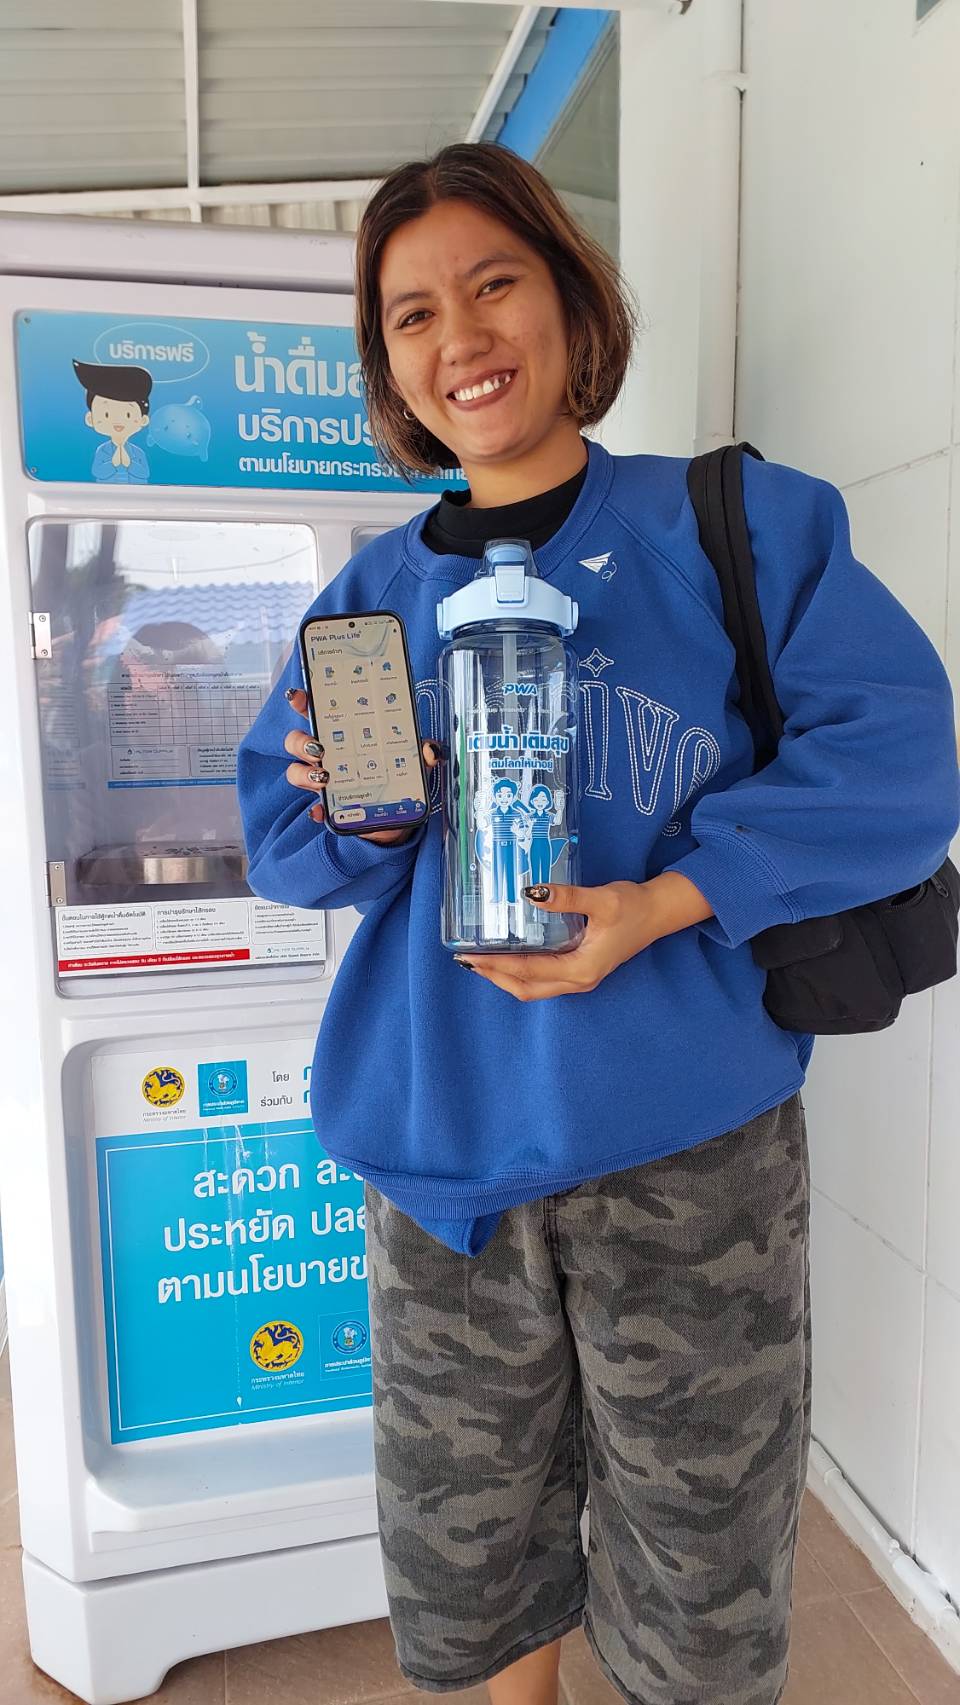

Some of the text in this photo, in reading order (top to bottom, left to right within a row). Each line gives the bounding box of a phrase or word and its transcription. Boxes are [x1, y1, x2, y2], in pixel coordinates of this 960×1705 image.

[109, 340, 194, 363] บริการฟรี
[503, 682, 538, 696] PWA
[521, 730, 570, 757] เติมสุข
[272, 1070, 290, 1083] โดย
[260, 1095, 293, 1107] ร่วมกับ
[193, 1162, 300, 1198] สะดวก
[163, 1208, 294, 1252] ประหยัด
